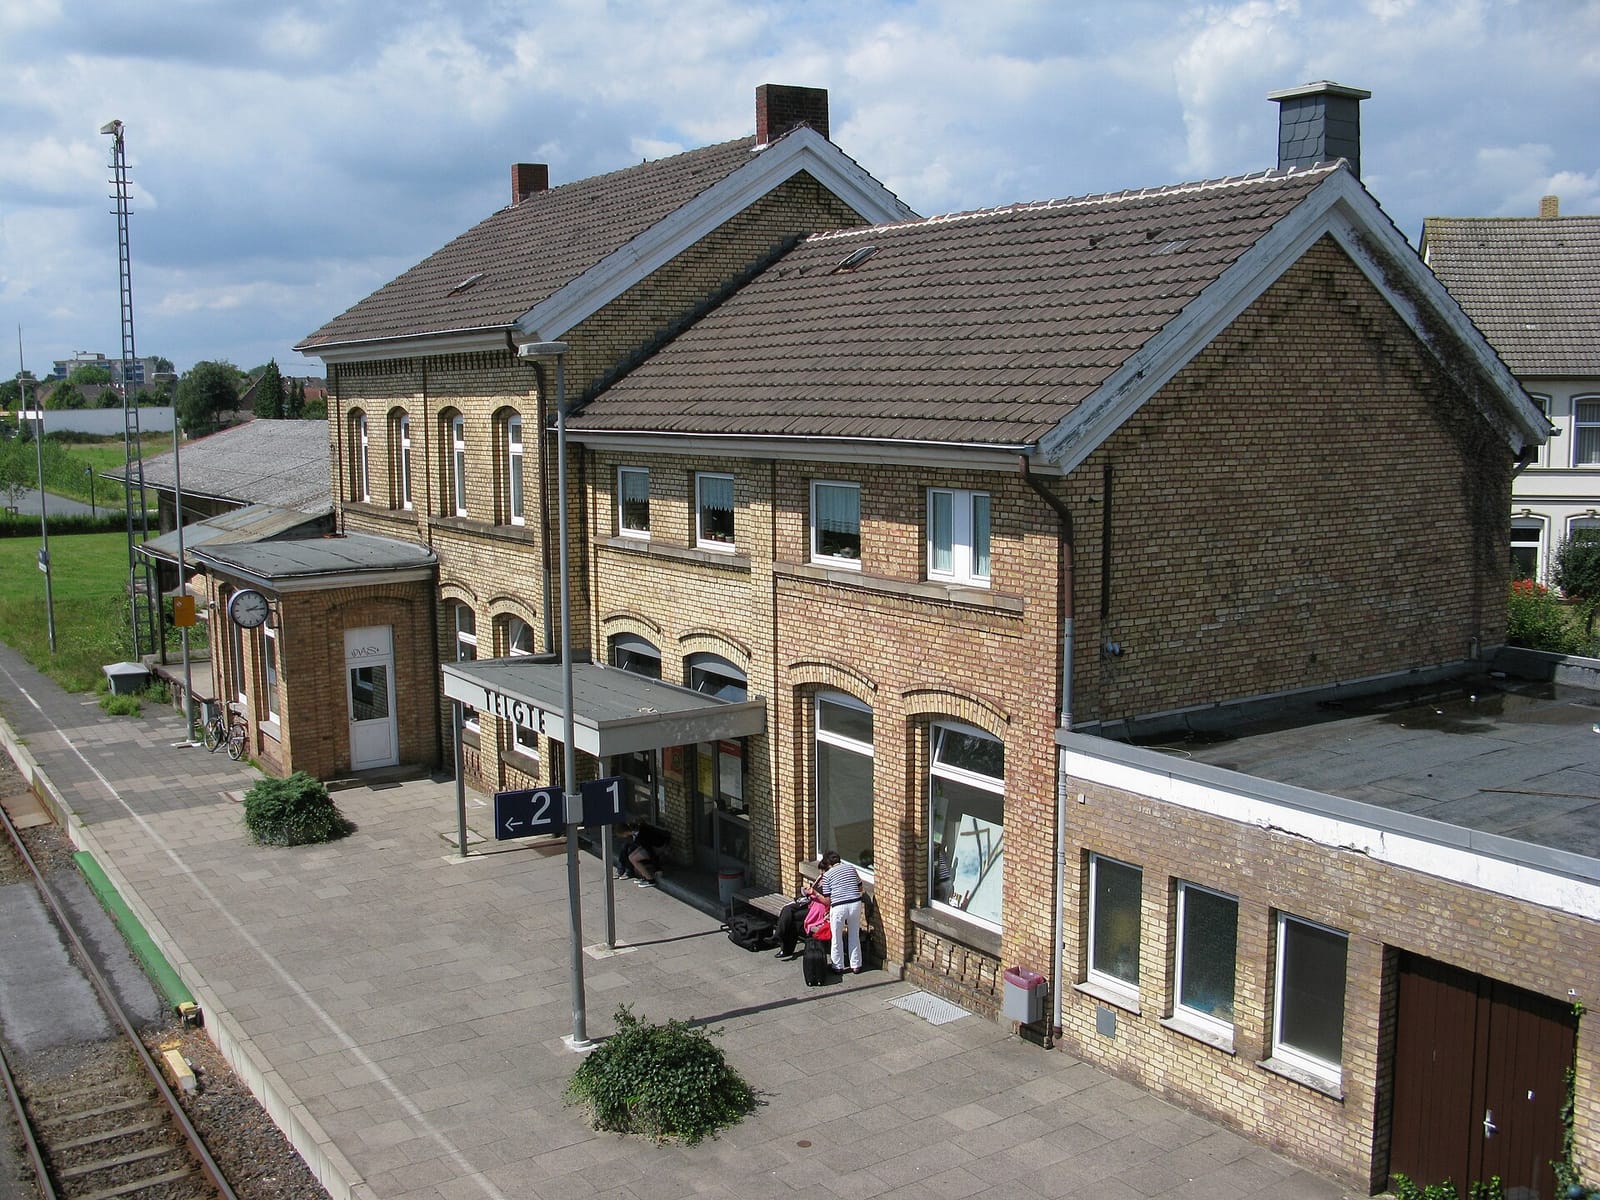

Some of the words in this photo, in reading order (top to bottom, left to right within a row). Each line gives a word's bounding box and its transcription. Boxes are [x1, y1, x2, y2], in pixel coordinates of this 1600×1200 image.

[484, 688, 546, 734] TELGTE
[531, 791, 551, 825] 2
[606, 781, 620, 813] 1
